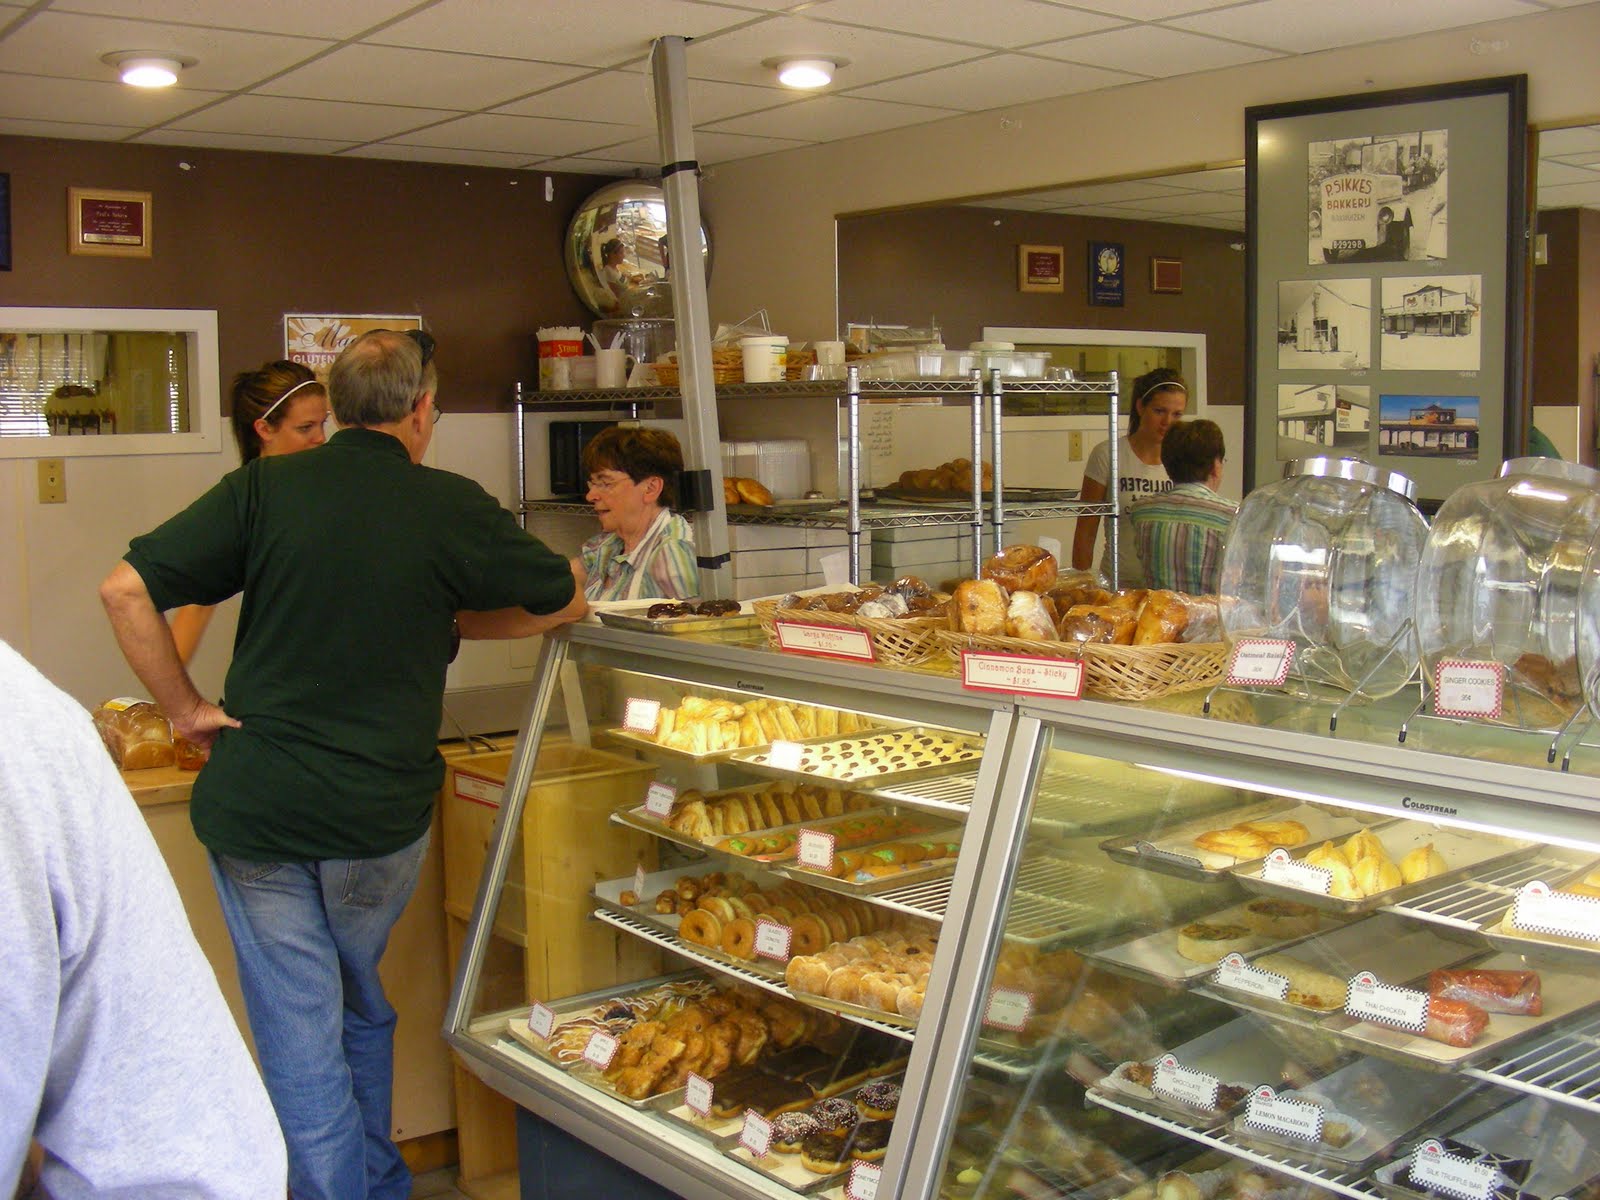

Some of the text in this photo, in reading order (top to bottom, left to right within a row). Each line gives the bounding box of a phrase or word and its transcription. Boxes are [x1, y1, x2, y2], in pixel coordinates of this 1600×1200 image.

[293, 354, 336, 364] GLUTEN
[978, 661, 1015, 674] Cinnamon
[1015, 665, 1036, 675] Buns
[1043, 668, 1067, 680] Sticky
[1402, 796, 1458, 815] COLDSTREAM
[1379, 1005, 1407, 1016] CHICKEN
[1255, 1109, 1310, 1128] LEMON MACAROON
[1426, 1167, 1482, 1191] SILK TRUFFLE BAR
